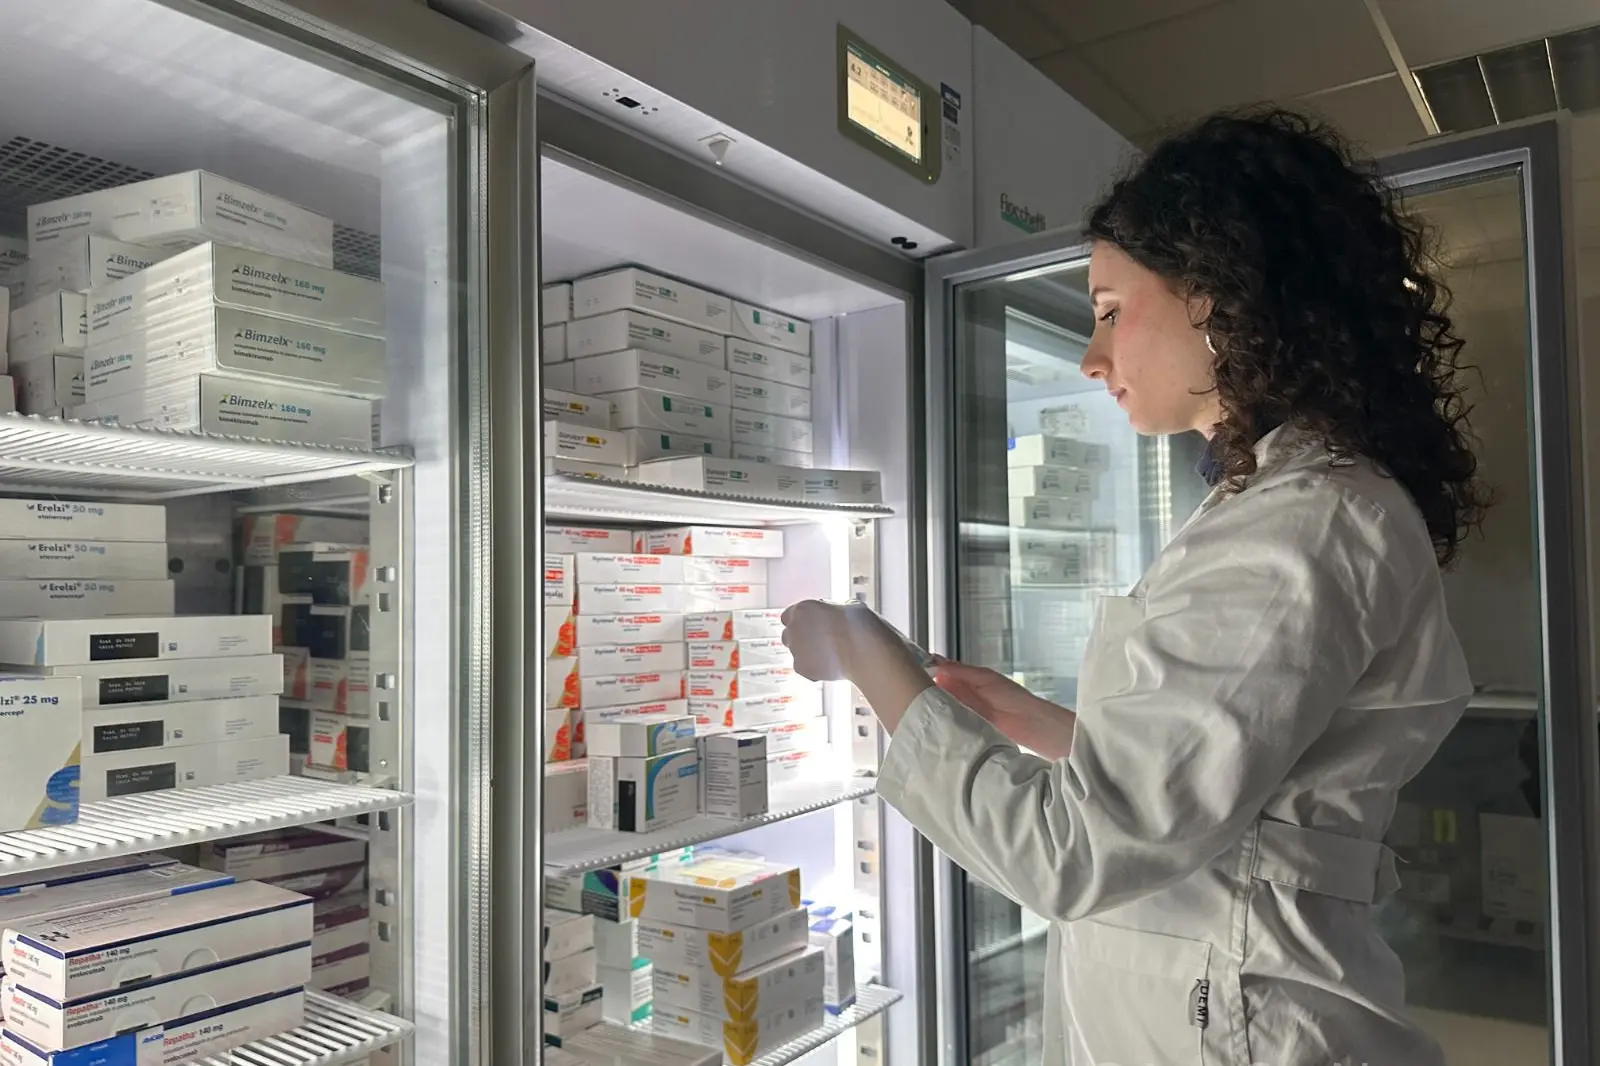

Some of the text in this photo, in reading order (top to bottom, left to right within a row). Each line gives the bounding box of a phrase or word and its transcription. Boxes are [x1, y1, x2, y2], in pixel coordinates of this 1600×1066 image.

[242, 265, 290, 285] Bimzelx
[312, 281, 325, 294] mg
[244, 329, 290, 347] Bimzelx
[312, 345, 326, 355] mg
[229, 395, 311, 417] Bimzelx 160 mg
[88, 506, 104, 516] mg
[90, 546, 105, 555] mg
[98, 584, 115, 593] mg
[23, 695, 38, 705] 25
[40, 696, 59, 706] mg
[119, 947, 130, 956] mg
[117, 995, 128, 1004] mg
